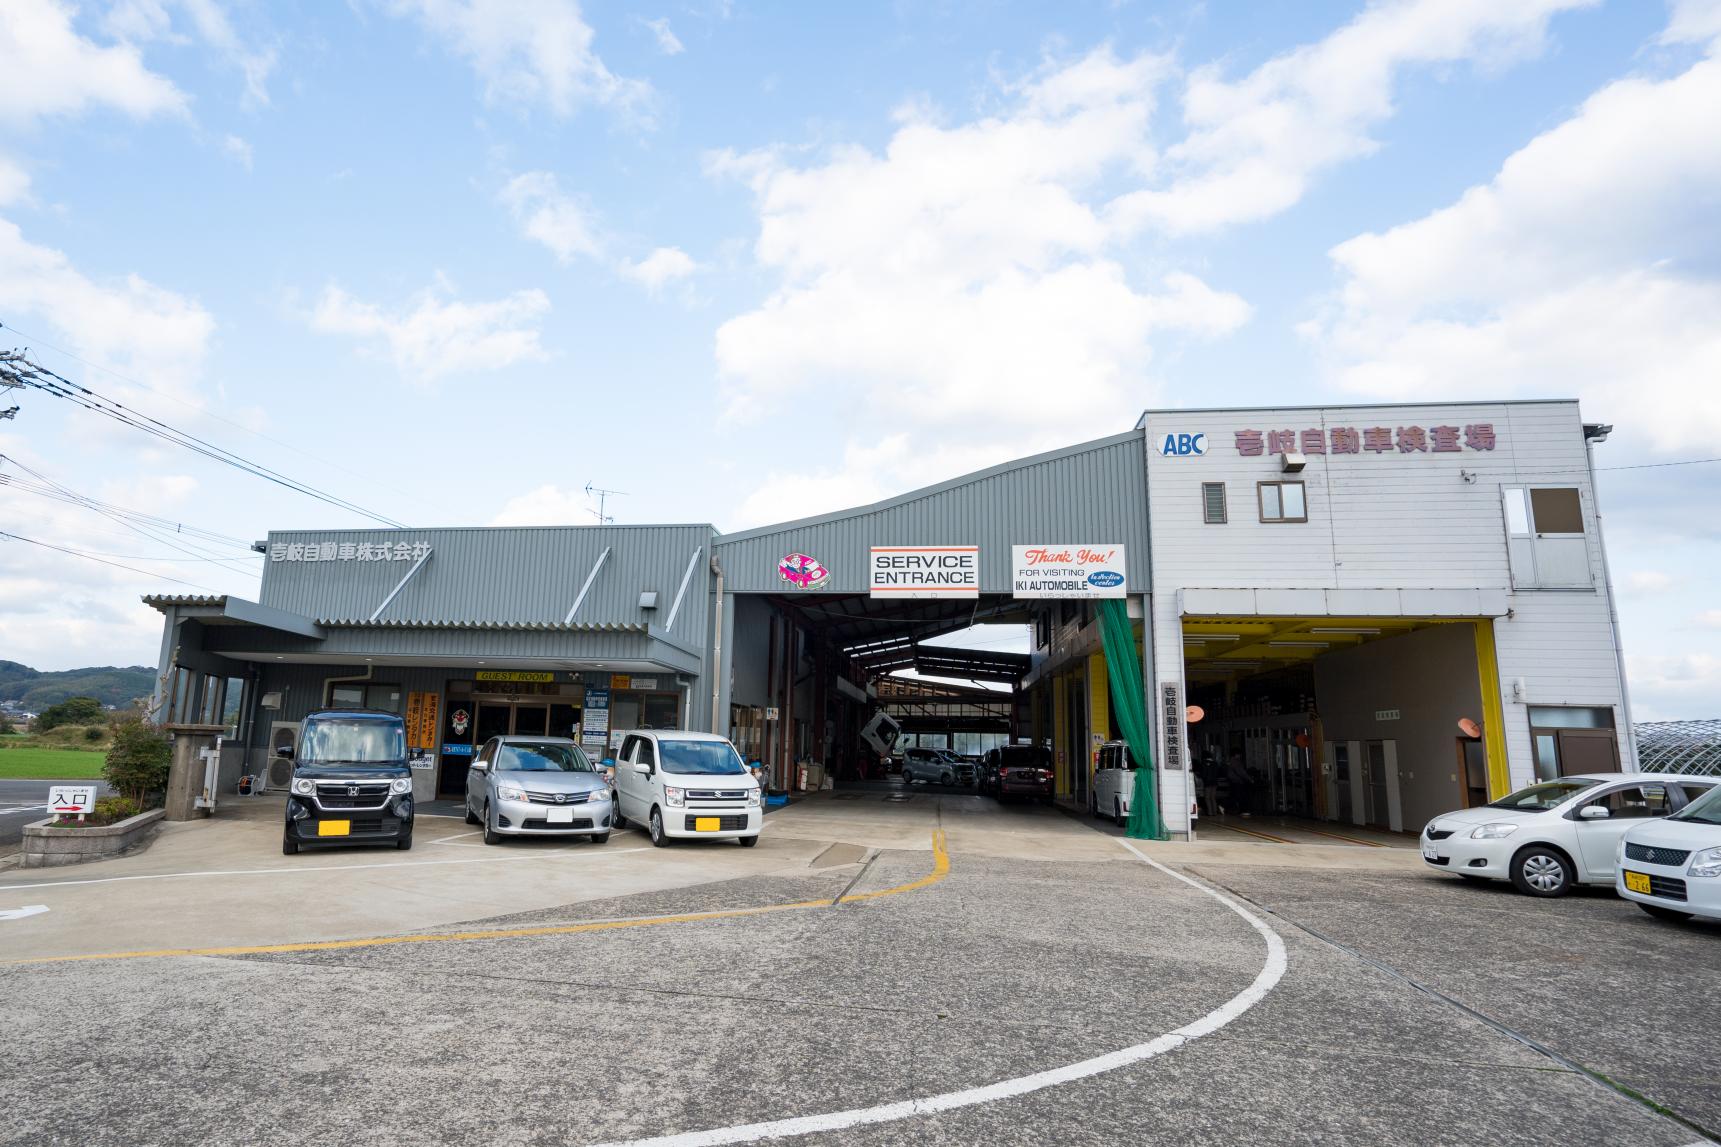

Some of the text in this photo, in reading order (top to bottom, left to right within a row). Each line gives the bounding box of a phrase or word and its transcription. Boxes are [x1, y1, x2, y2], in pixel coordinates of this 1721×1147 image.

[1163, 433, 1205, 455] ABC
[1234, 423, 1497, 456] 壱岐自動車検査場
[270, 541, 431, 562] 壱岐自動車株式会社
[1025, 548, 1116, 566] Thank You!
[876, 555, 973, 569] SERVICE
[874, 571, 975, 584] ENTRANCE
[1019, 568, 1085, 577] FOR VISITING
[1015, 580, 1088, 591] IKI AUTOMOBILE
[481, 672, 549, 681] GUEST ROOM
[1165, 687, 1179, 765] 壱岐自動車検査場
[52, 794, 87, 805] 入口
